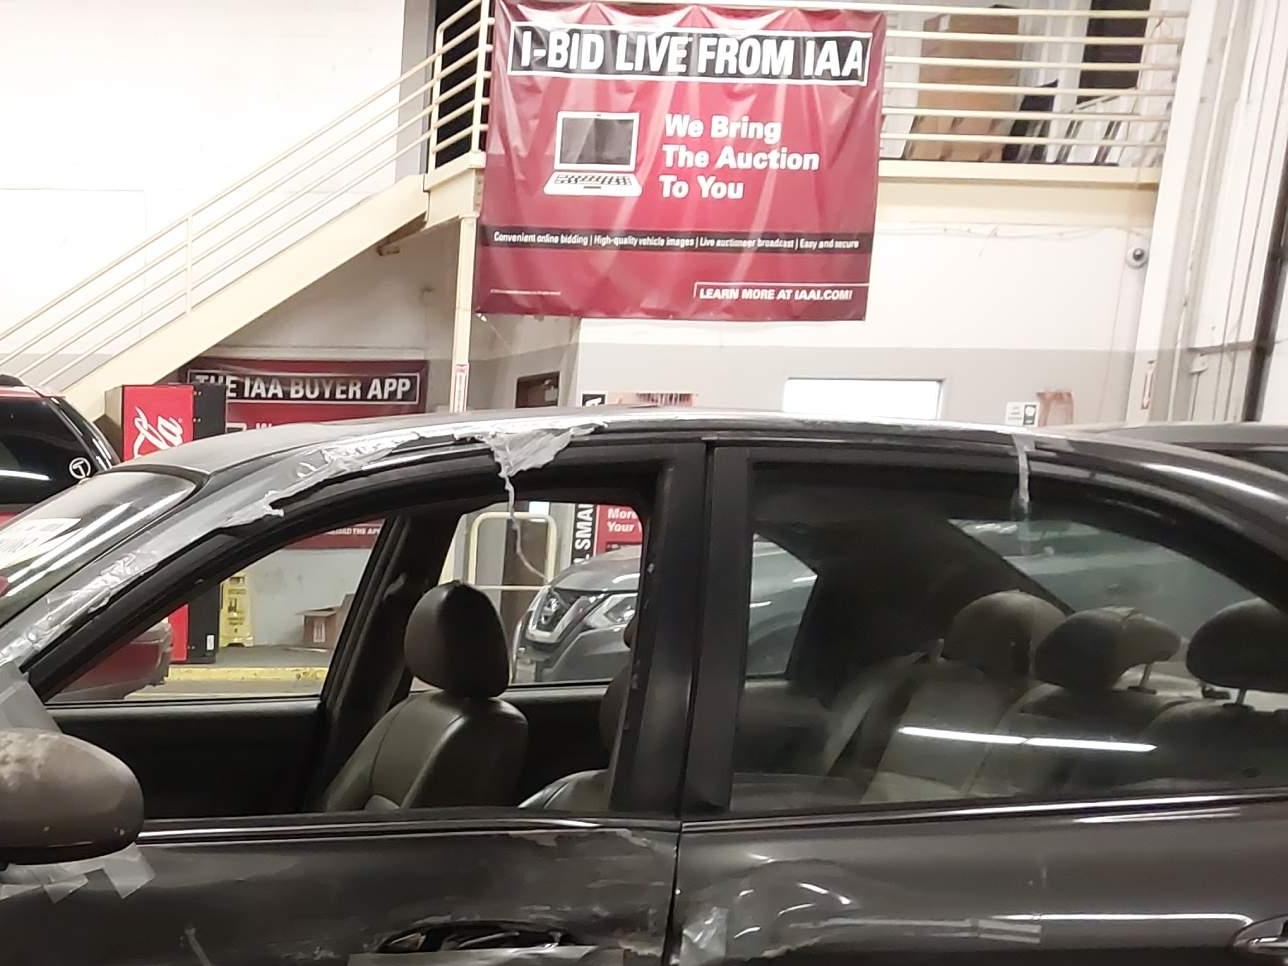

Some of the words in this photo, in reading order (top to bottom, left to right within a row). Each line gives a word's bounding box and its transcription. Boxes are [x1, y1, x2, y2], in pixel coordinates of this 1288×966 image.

[521, 30, 605, 70] I-BID
[615, 34, 688, 73] LIVE
[697, 36, 795, 76] FROM
[803, 40, 864, 77] IAA
[664, 114, 704, 138] We
[711, 115, 782, 144] Bring
[662, 144, 710, 168] The
[715, 146, 820, 171] Auction
[659, 175, 689, 198] To
[697, 175, 744, 199] You
[494, 231, 536, 243] Convenient
[560, 234, 588, 246] bidding
[666, 237, 694, 248] images
[700, 236, 715, 247] Live
[799, 238, 817, 250] Easy
[700, 288, 739, 299] LEARN
[741, 288, 775, 299] MORE
[776, 289, 793, 300] AT
[244, 375, 284, 398] IAA
[289, 378, 362, 400] BUYER
[366, 378, 412, 400] APP
[606, 521, 635, 532] Your
